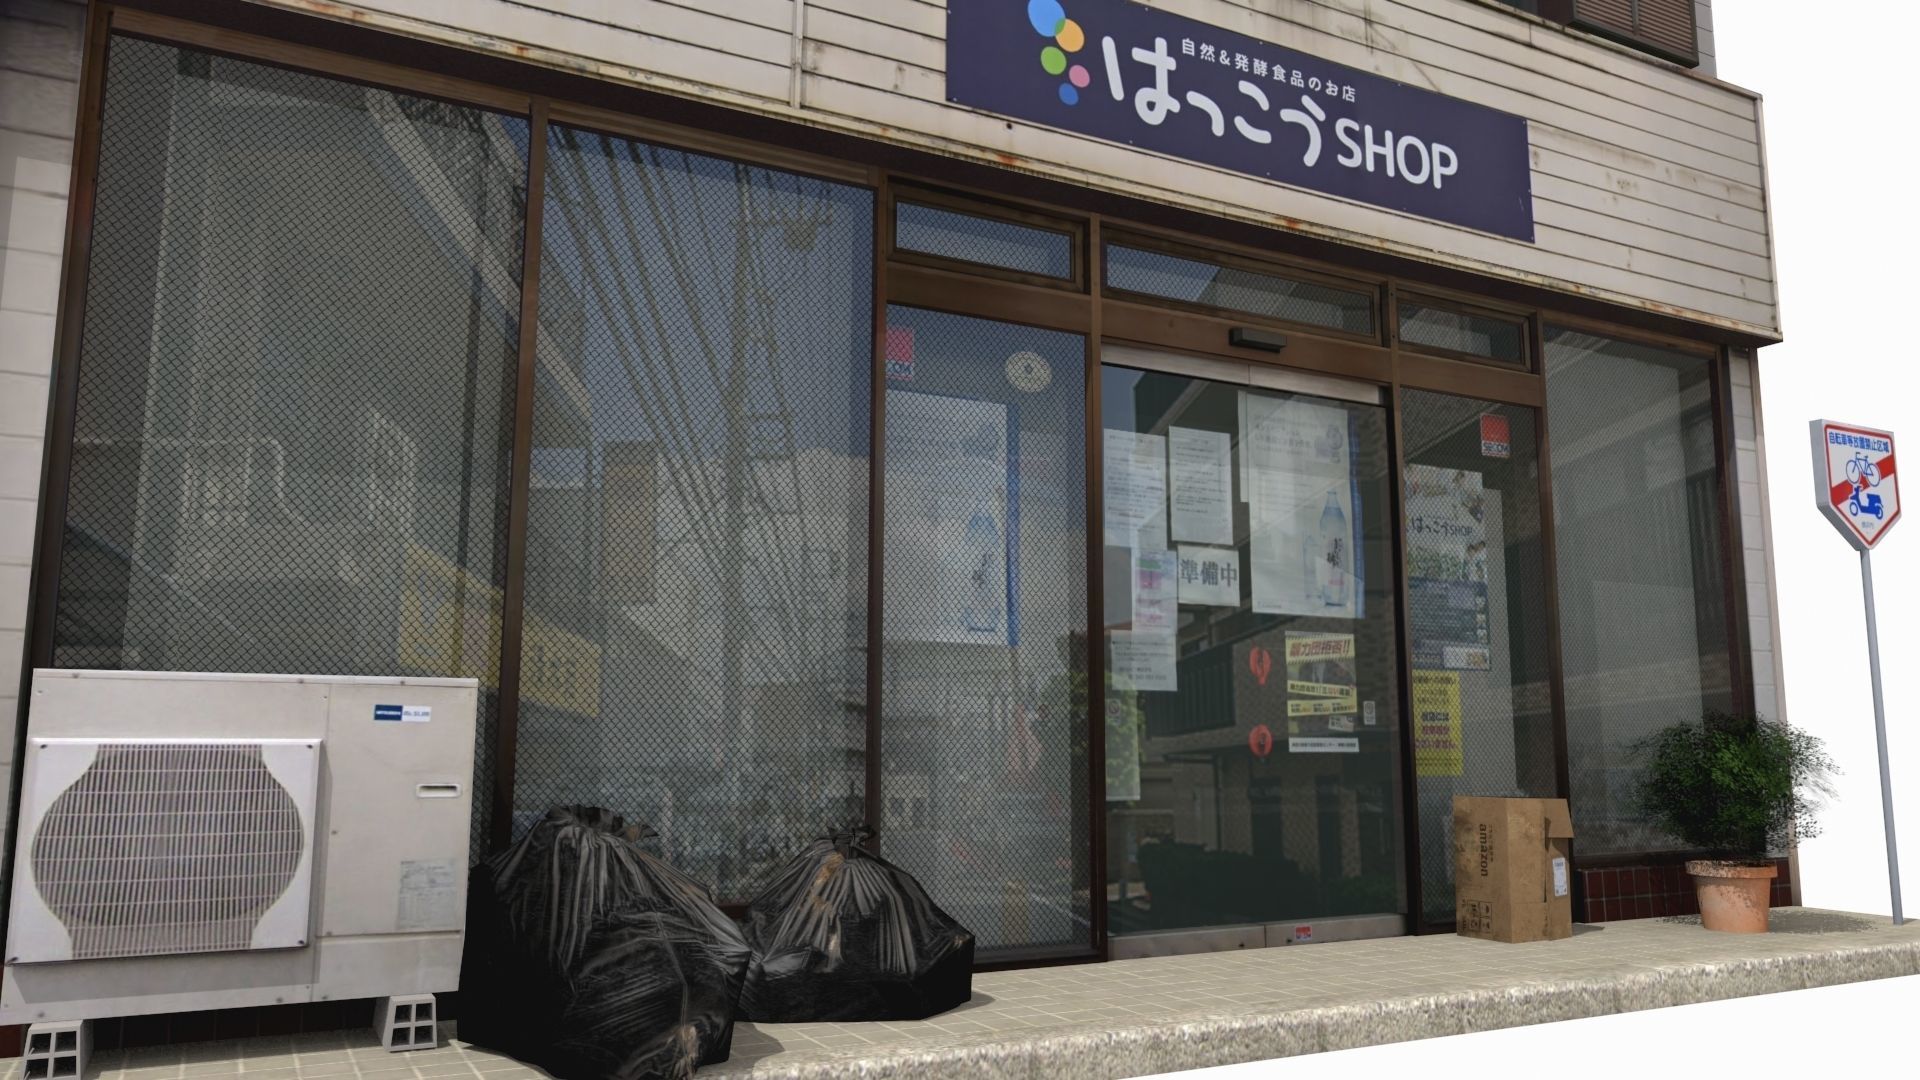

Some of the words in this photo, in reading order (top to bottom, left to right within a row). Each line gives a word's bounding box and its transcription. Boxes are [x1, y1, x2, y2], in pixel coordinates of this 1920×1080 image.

[1182, 37, 1356, 103] 自然&発酵食品のお店
[1179, 558, 1238, 587] 準備中
[1479, 823, 1488, 877] amazon
